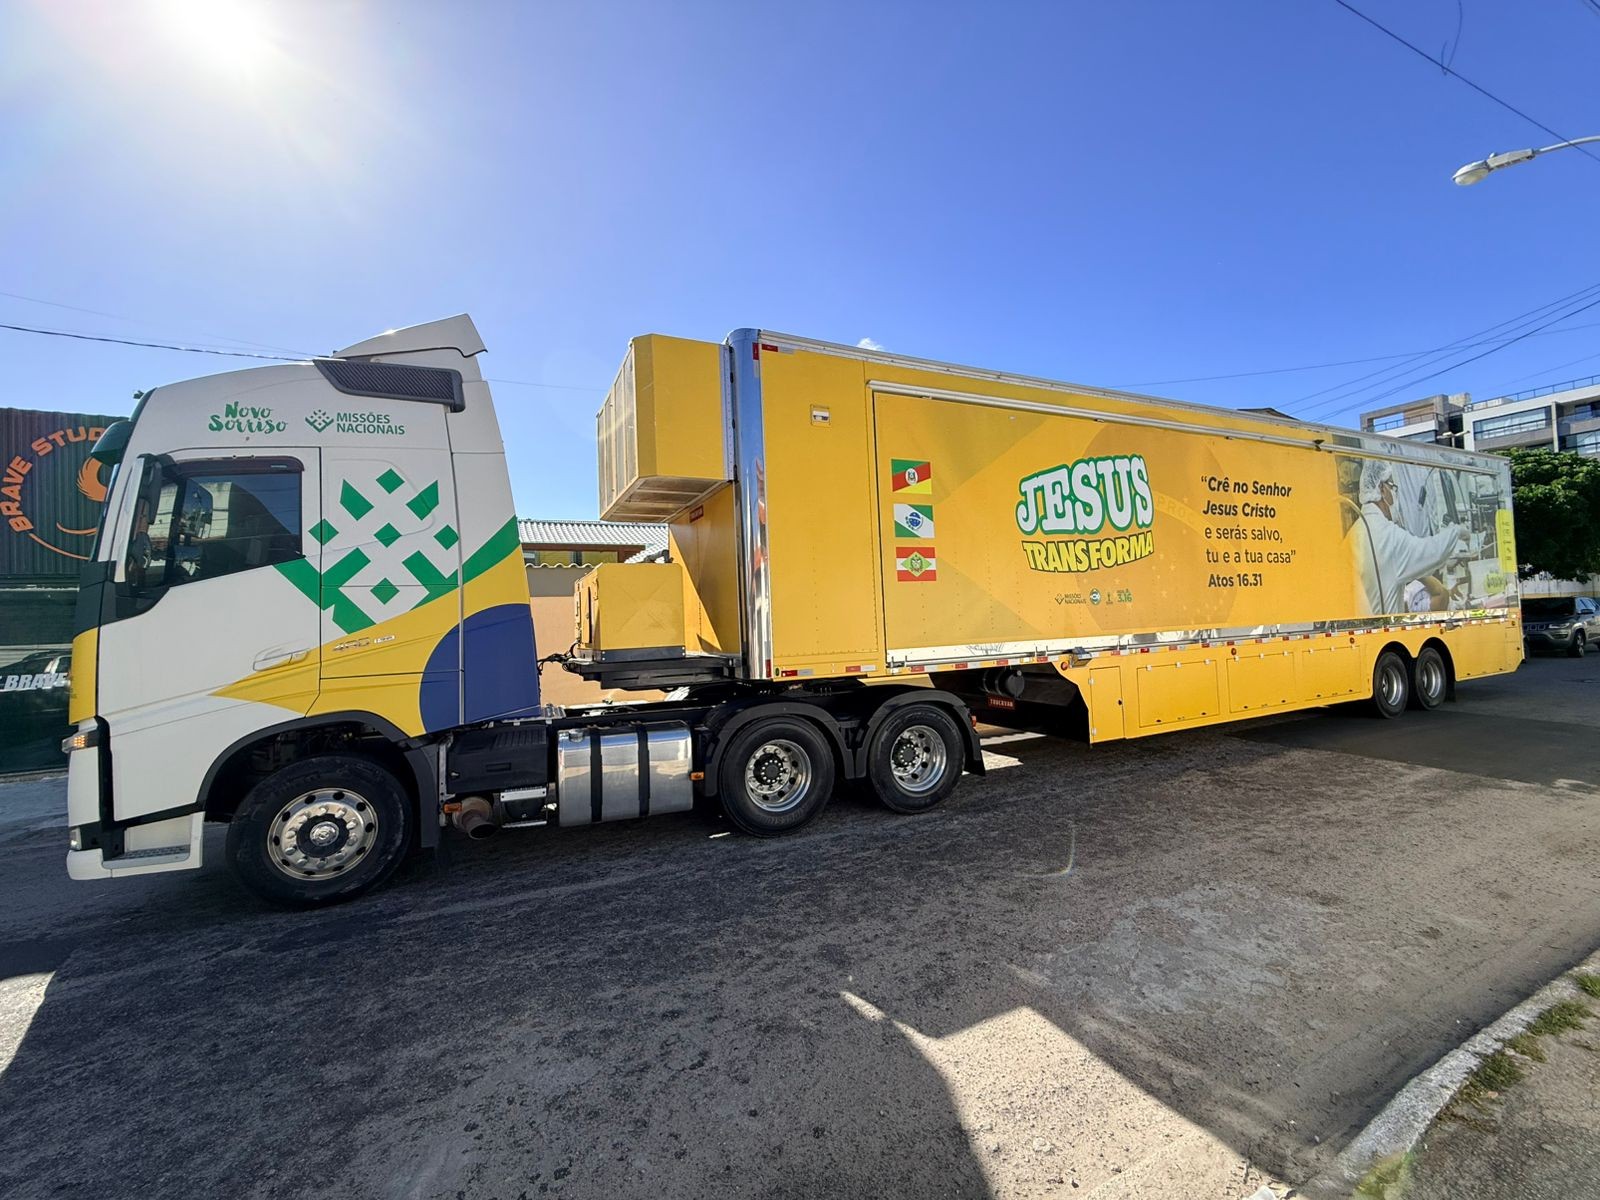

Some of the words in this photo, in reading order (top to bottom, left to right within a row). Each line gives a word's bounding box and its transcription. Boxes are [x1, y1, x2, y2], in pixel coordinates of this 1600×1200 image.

[225, 401, 274, 418] Novo
[336, 411, 390, 424] MISSÕES
[208, 414, 289, 434] Sorriso
[336, 423, 405, 435] NACIONAIS
[0, 455, 34, 532] BRAVE
[1016, 454, 1154, 535] JESUS
[1233, 481, 1248, 493] no
[1252, 480, 1292, 497] Senhor
[1202, 500, 1238, 516] Jesus
[1242, 502, 1276, 518] Cristo
[1205, 527, 1212, 539] e
[1216, 524, 1247, 540] serás
[1251, 526, 1283, 543] salvo,
[1021, 529, 1155, 573] TRANSFORMA
[1206, 548, 1219, 563] tu
[1223, 551, 1230, 563] e
[1234, 551, 1241, 563] a
[1245, 549, 1263, 563] tua
[1208, 573, 1234, 587] Atos
[1237, 573, 1262, 587] 16.31
[4, 672, 69, 690] BRAVE
